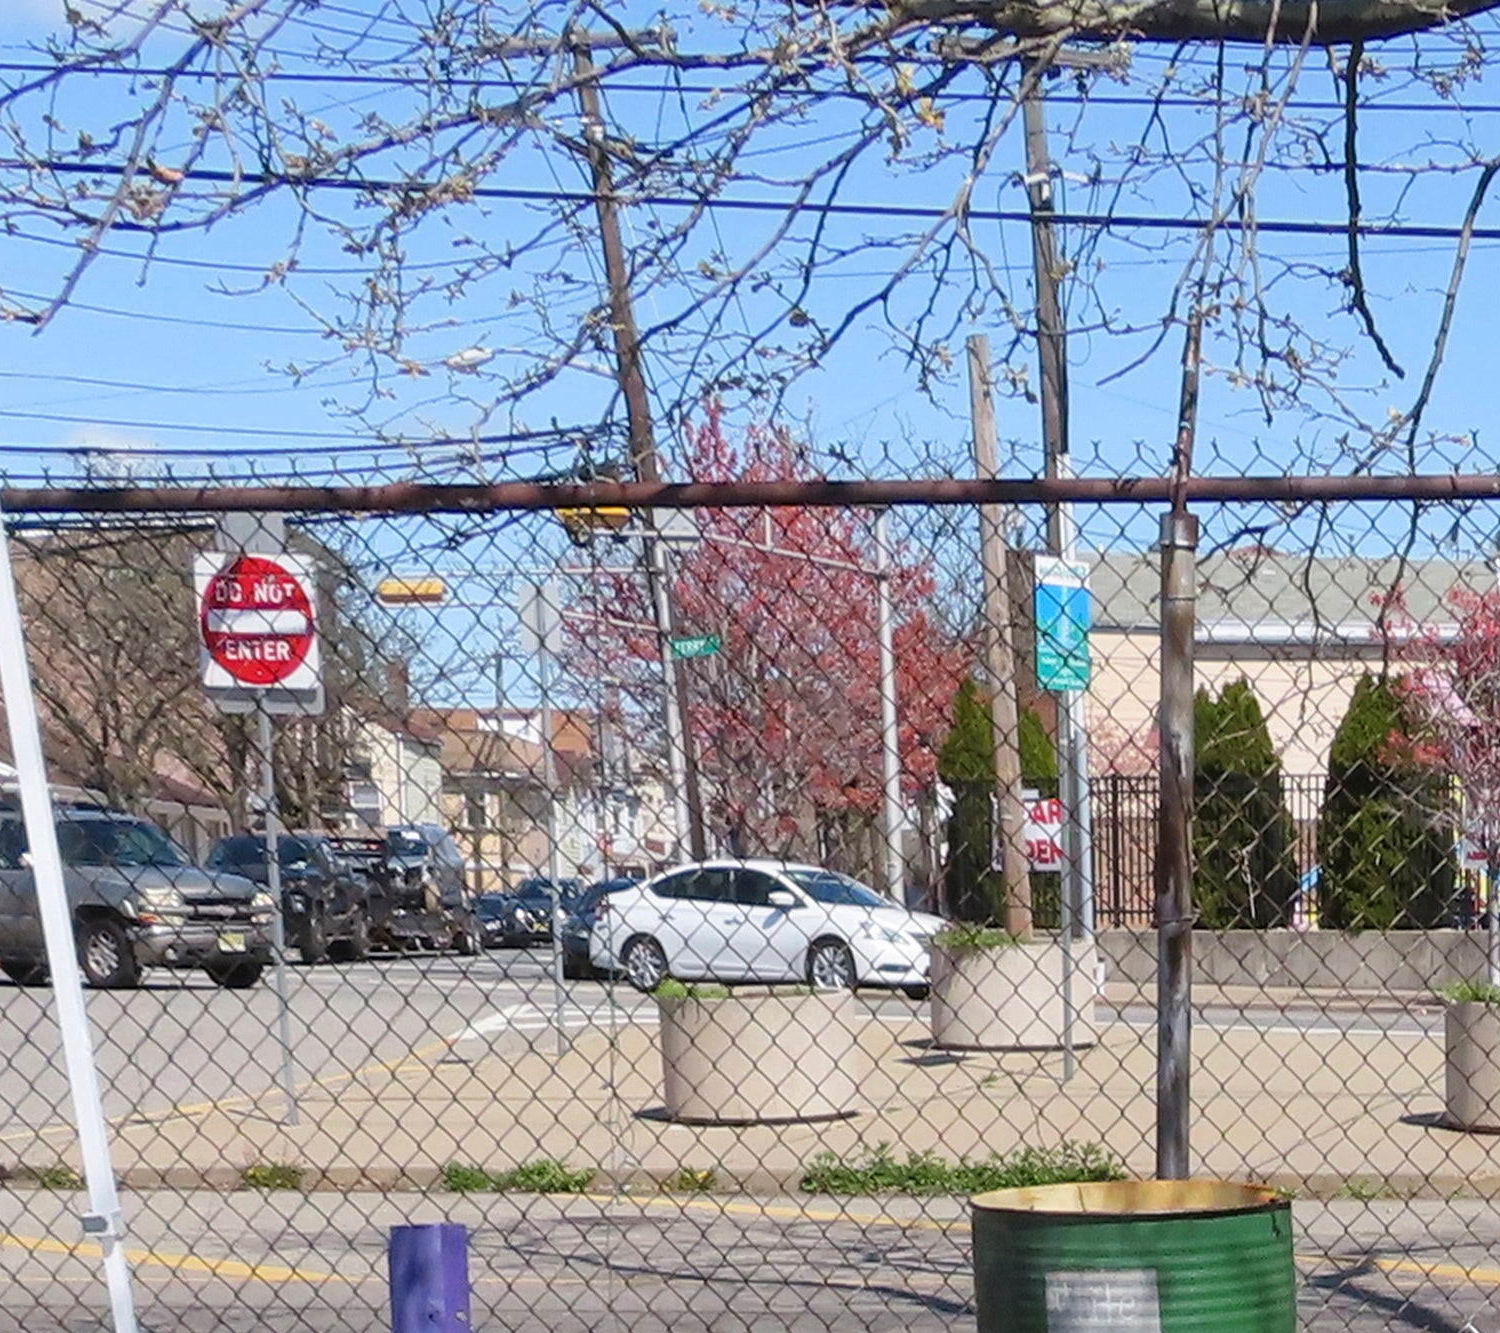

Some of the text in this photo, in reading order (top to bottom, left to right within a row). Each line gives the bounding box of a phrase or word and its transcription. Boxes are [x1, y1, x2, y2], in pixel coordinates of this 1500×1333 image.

[216, 581, 295, 603] DO NOT
[225, 639, 291, 661] ENTER
